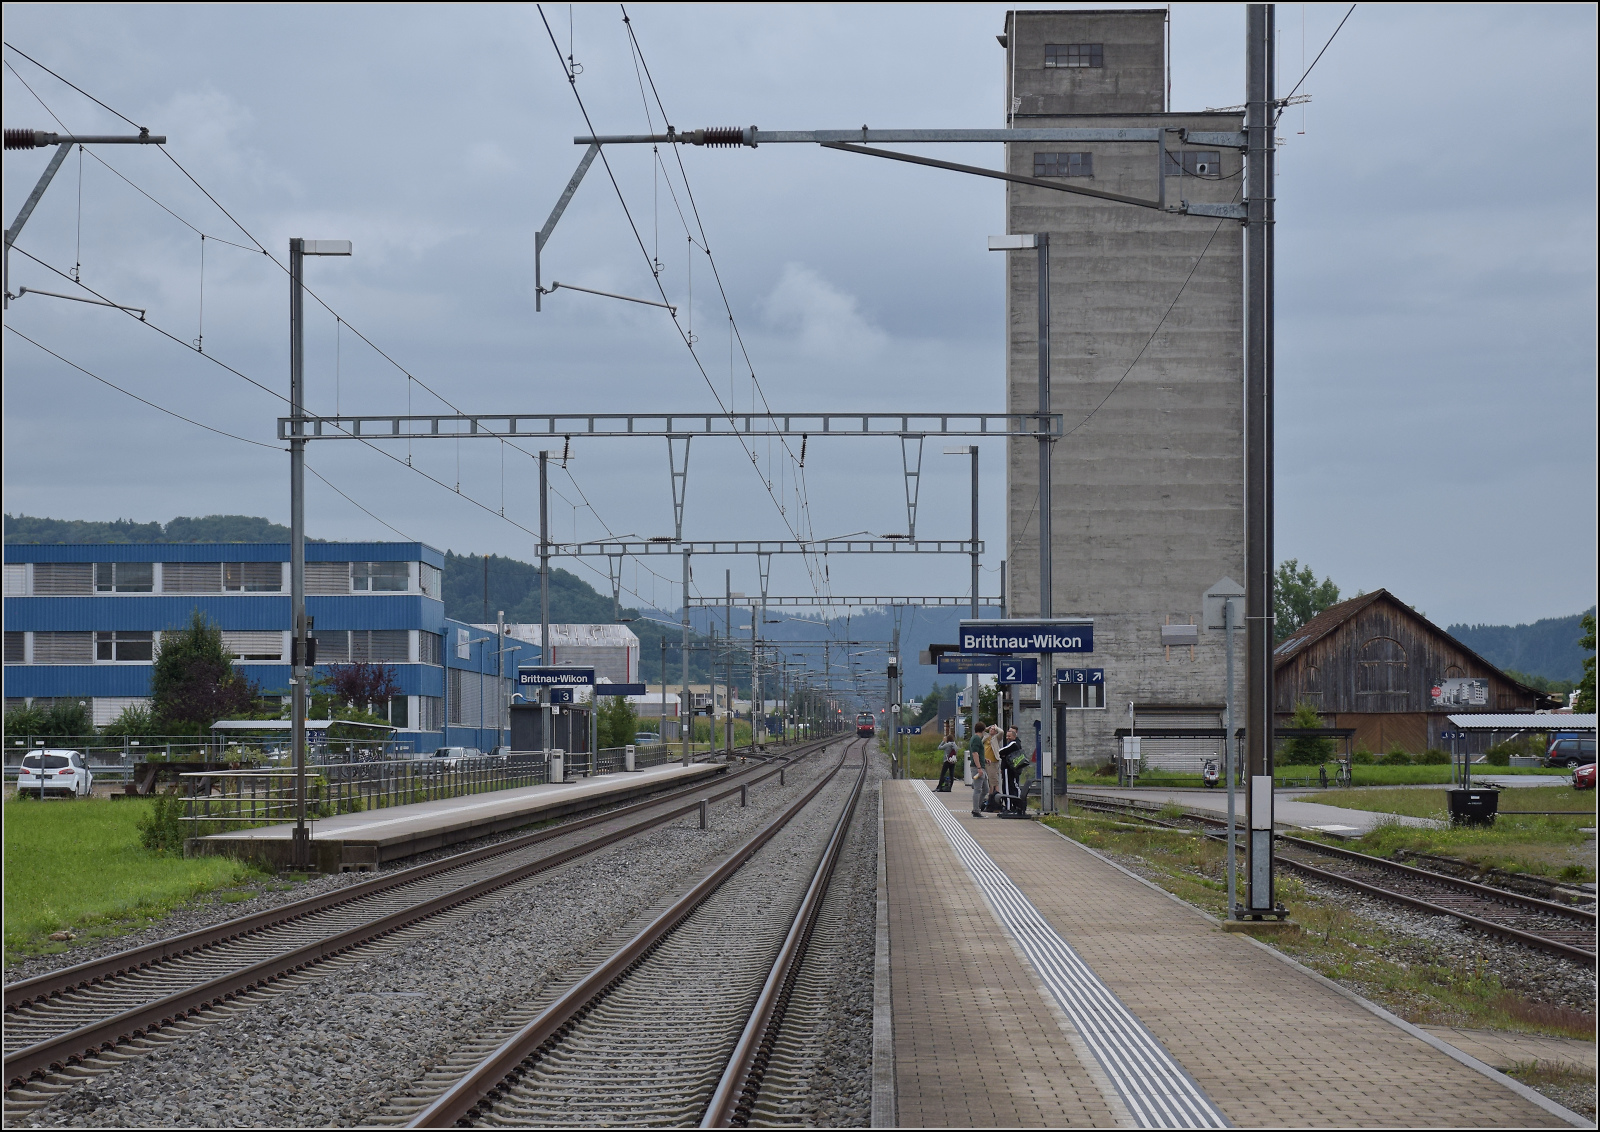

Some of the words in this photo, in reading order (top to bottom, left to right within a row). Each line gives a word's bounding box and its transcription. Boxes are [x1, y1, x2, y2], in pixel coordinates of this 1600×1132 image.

[964, 634, 1082, 649] Brittnau-Wikon
[1006, 666, 1016, 680] 2
[1076, 673, 1084, 682] 3
[520, 674, 588, 683] Brittnau-Wikon
[562, 692, 570, 701] 3
